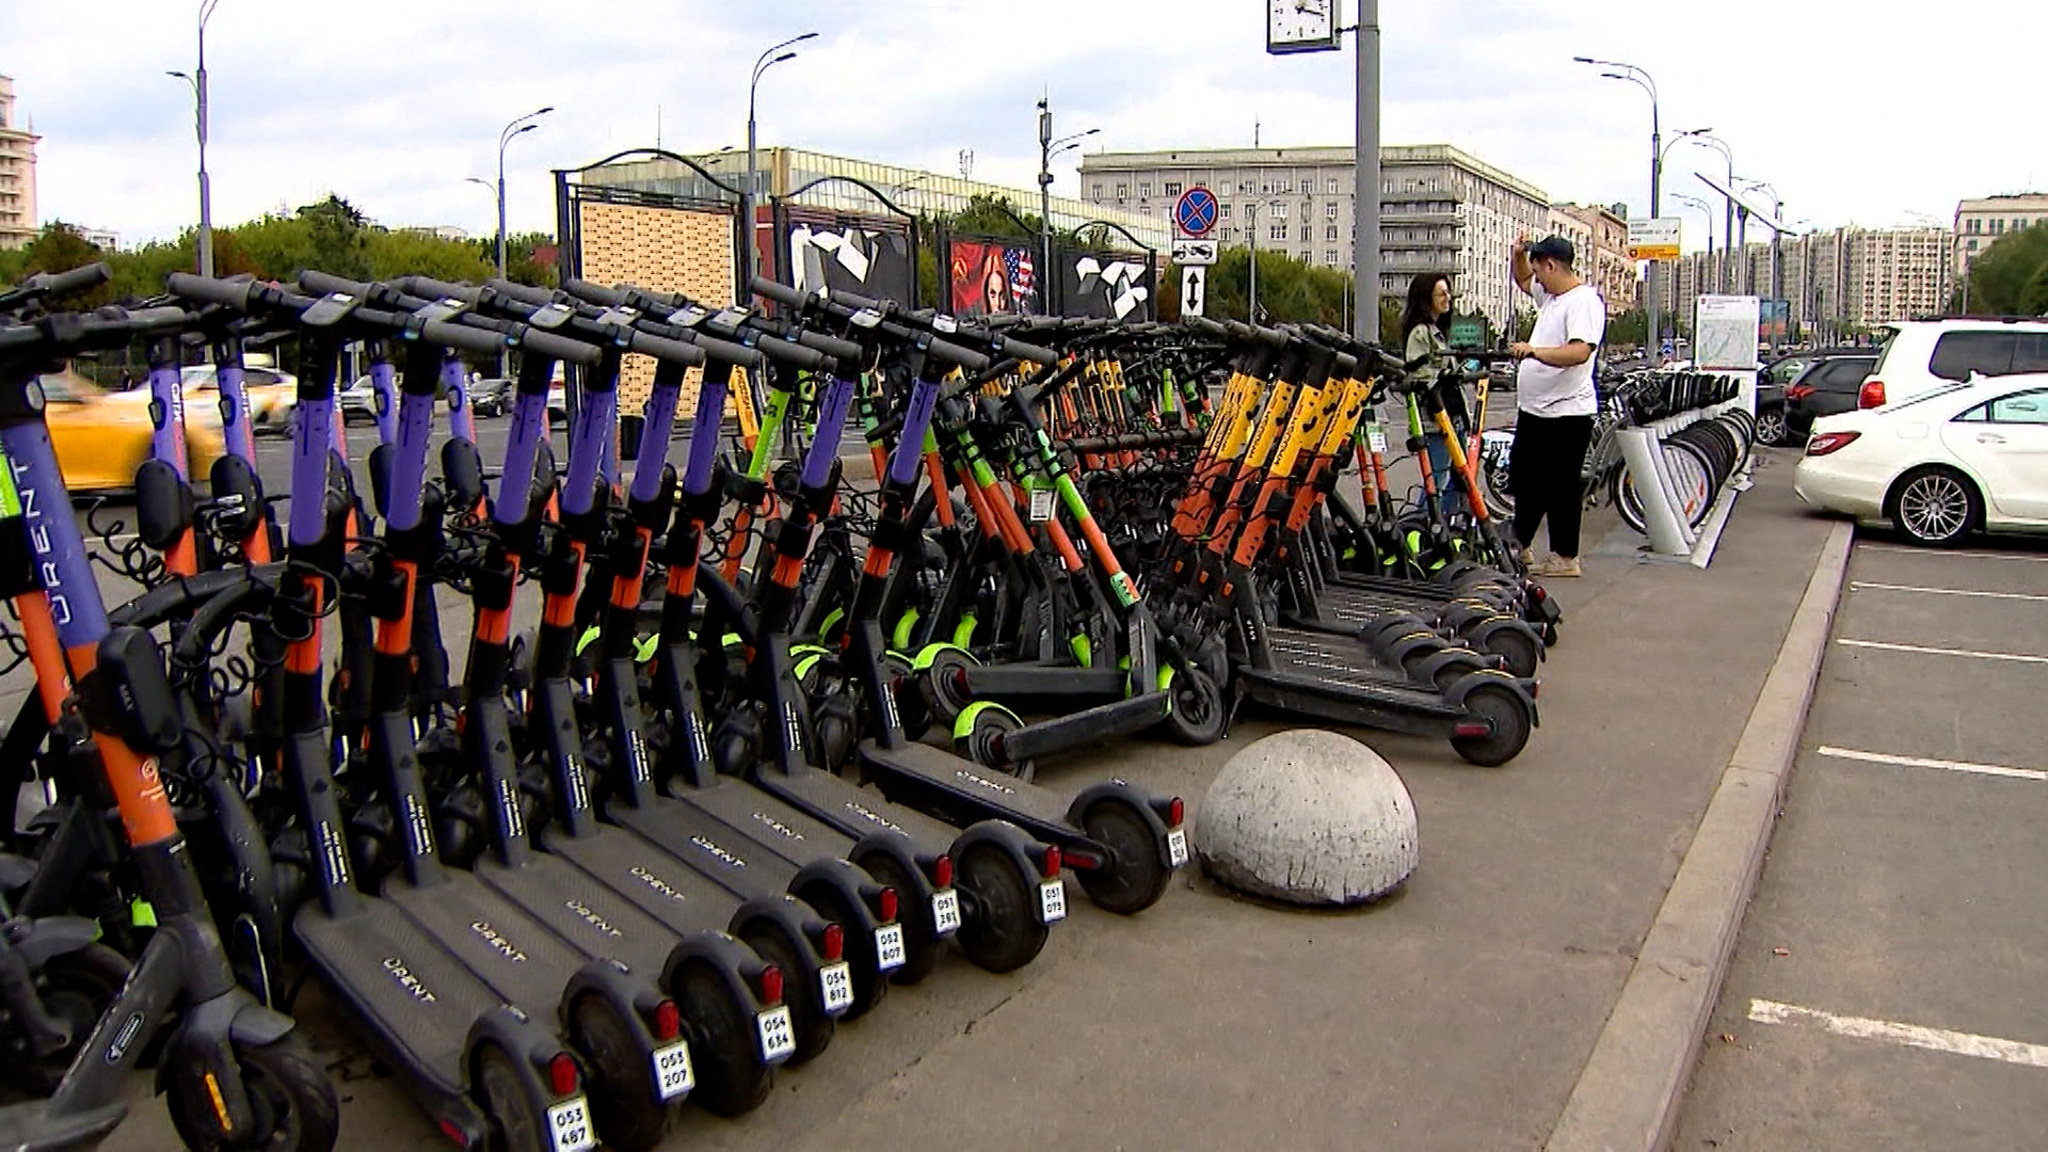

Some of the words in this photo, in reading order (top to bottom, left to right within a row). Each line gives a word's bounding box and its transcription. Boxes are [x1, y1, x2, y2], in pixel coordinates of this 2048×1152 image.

[10, 457, 72, 625] URENT
[383, 956, 436, 1003] URENT
[664, 1070, 687, 1088] 207
[556, 1106, 584, 1127] 053
[560, 1127, 587, 1146] 487
